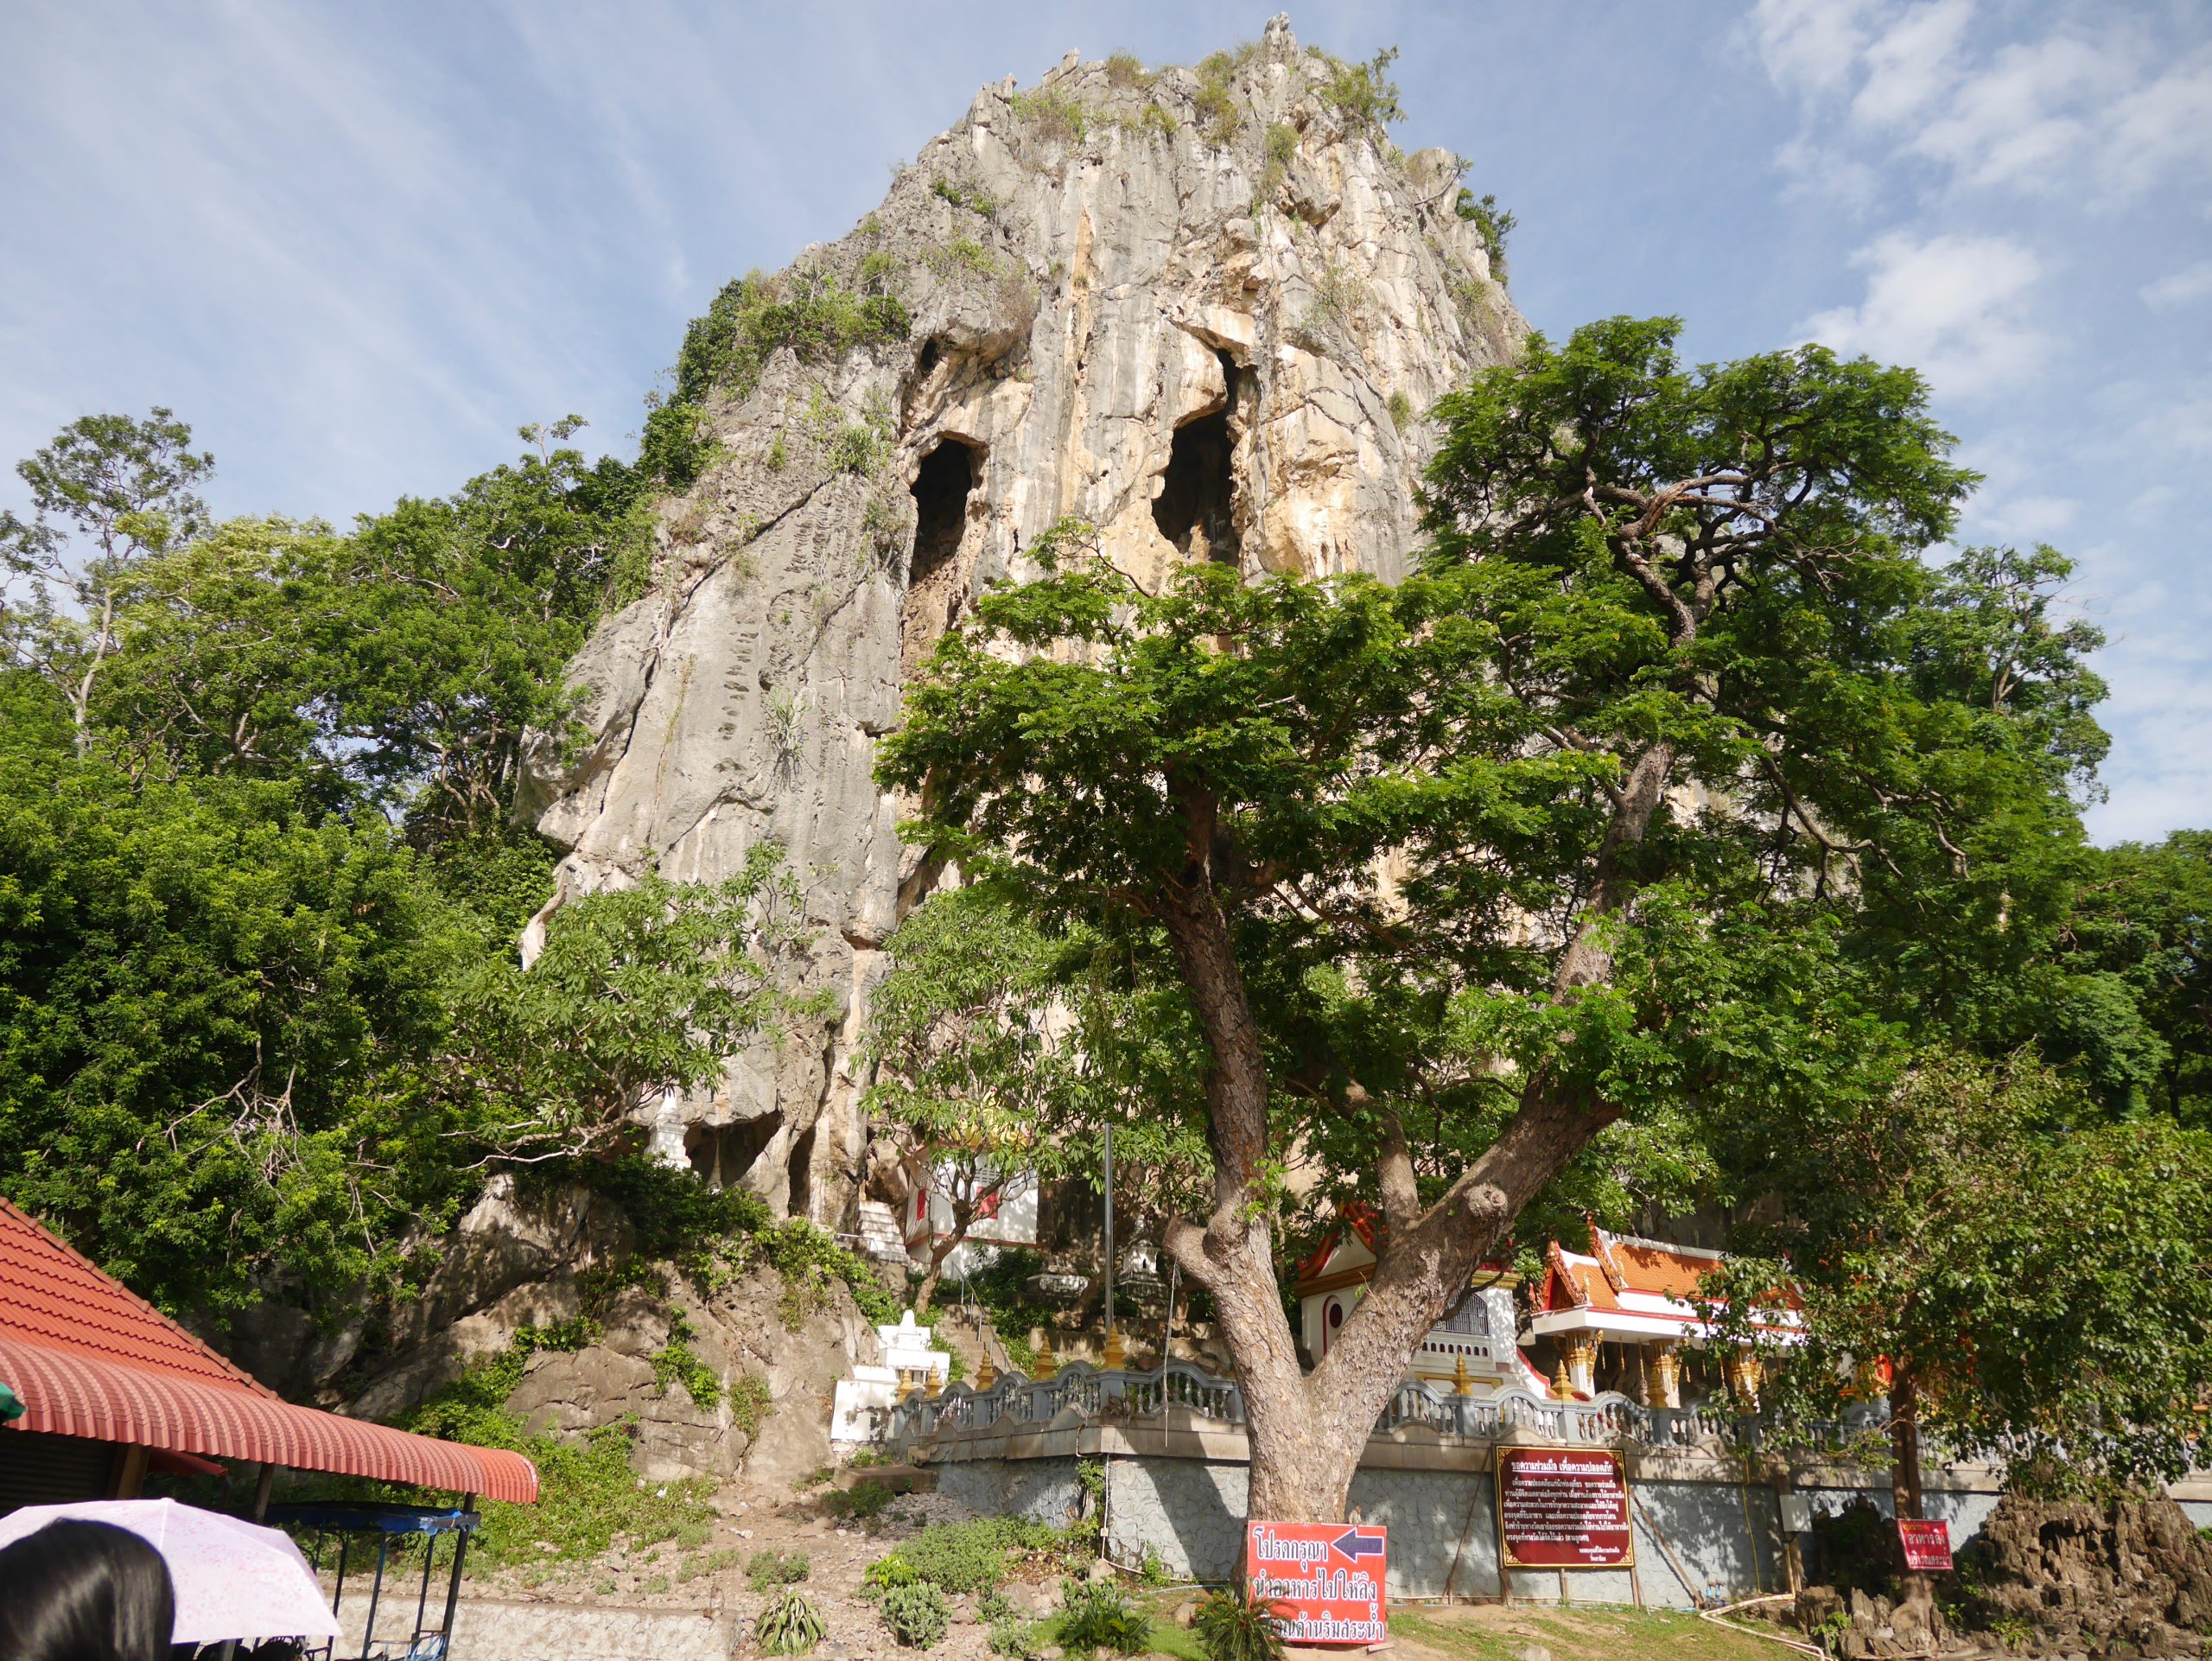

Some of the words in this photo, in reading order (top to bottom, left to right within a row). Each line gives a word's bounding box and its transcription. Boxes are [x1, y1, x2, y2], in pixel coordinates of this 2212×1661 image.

[1511, 1459, 1557, 1471] ขอความร่วมมือ
[1559, 1456, 1613, 1472] เพื่อความปลอดภัย
[1908, 1528, 1945, 1544] อาหารลิง
[1253, 1526, 1328, 1572] โปรดกรุณา
[1253, 1568, 1377, 1600] นำอาหารไปให้ลิง
